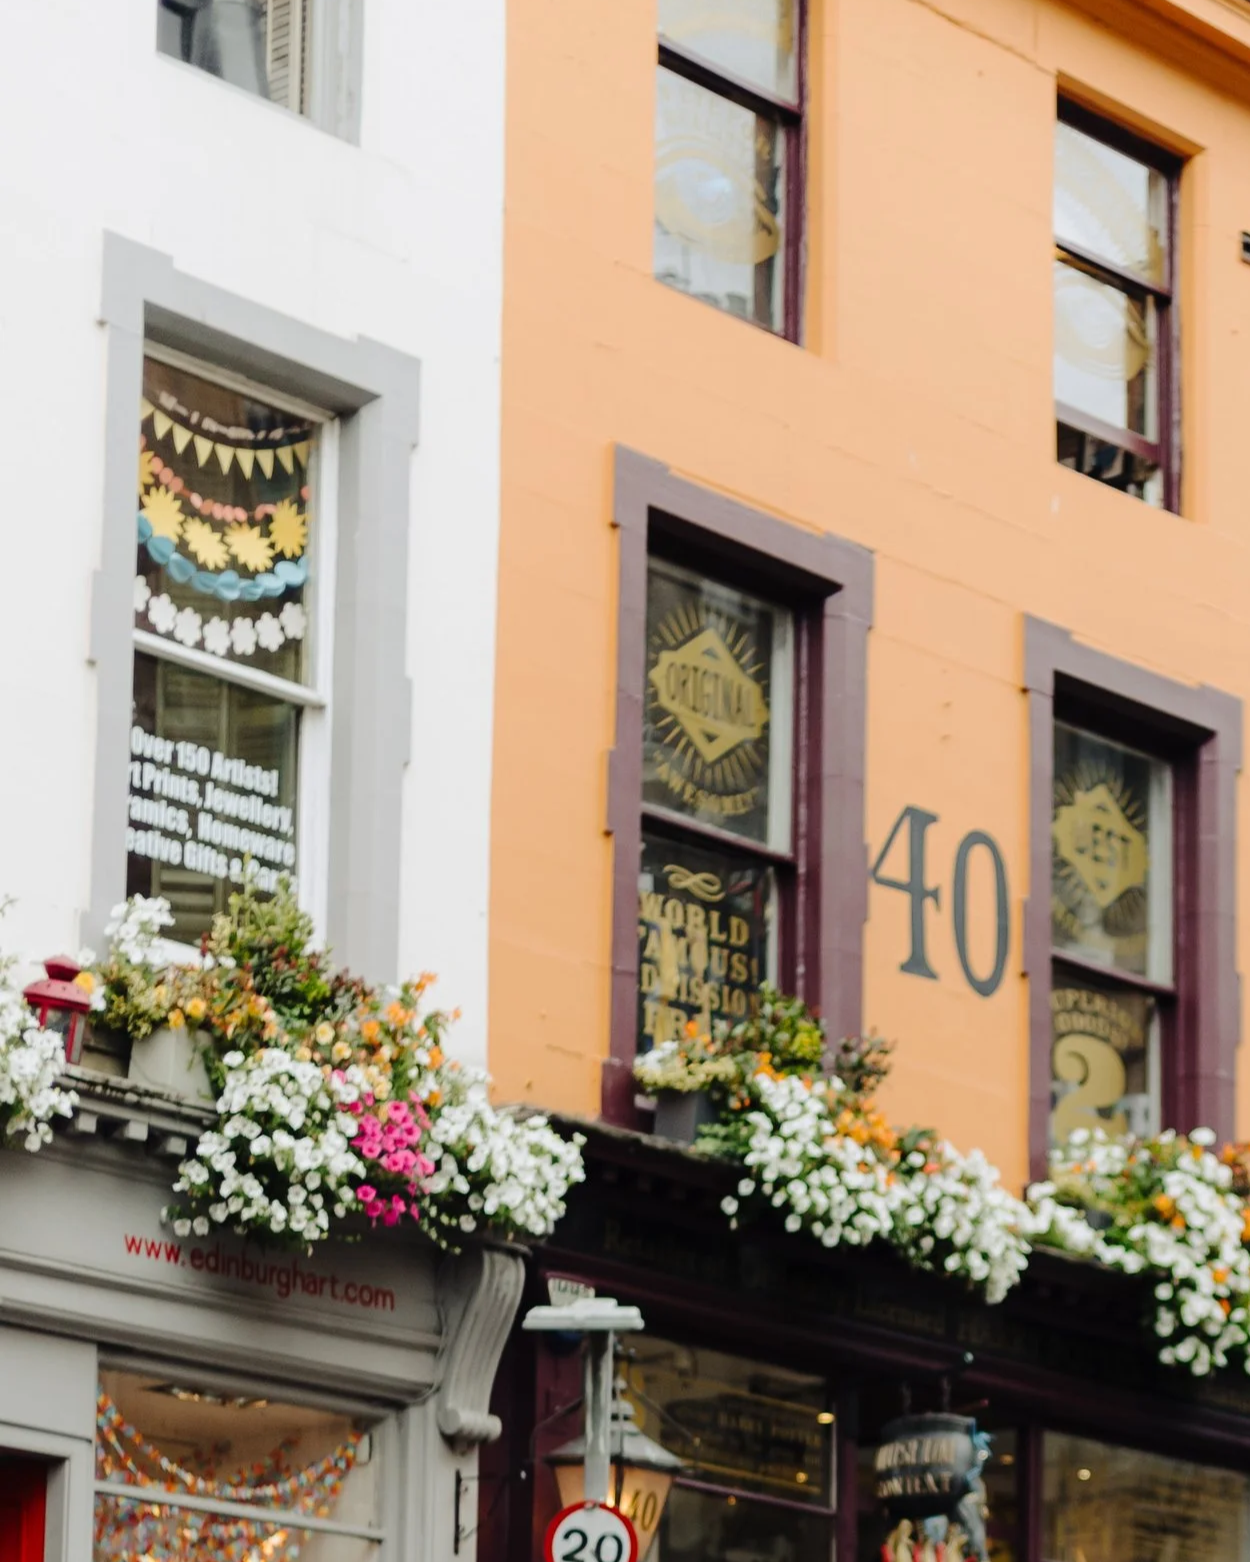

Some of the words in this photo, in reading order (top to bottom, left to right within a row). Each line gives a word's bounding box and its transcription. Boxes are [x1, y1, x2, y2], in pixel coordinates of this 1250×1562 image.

[131, 725, 174, 765] Over
[175, 740, 210, 776] 150
[211, 751, 279, 798] Artists!
[142, 761, 203, 809] Prints,
[204, 780, 294, 838] Jewellery,
[183, 839, 228, 880] Gifts
[197, 810, 296, 867] Homeware
[641, 892, 750, 947] WORLD
[870, 805, 1010, 997] 40
[123, 1233, 395, 1312] www.edinburghart.com
